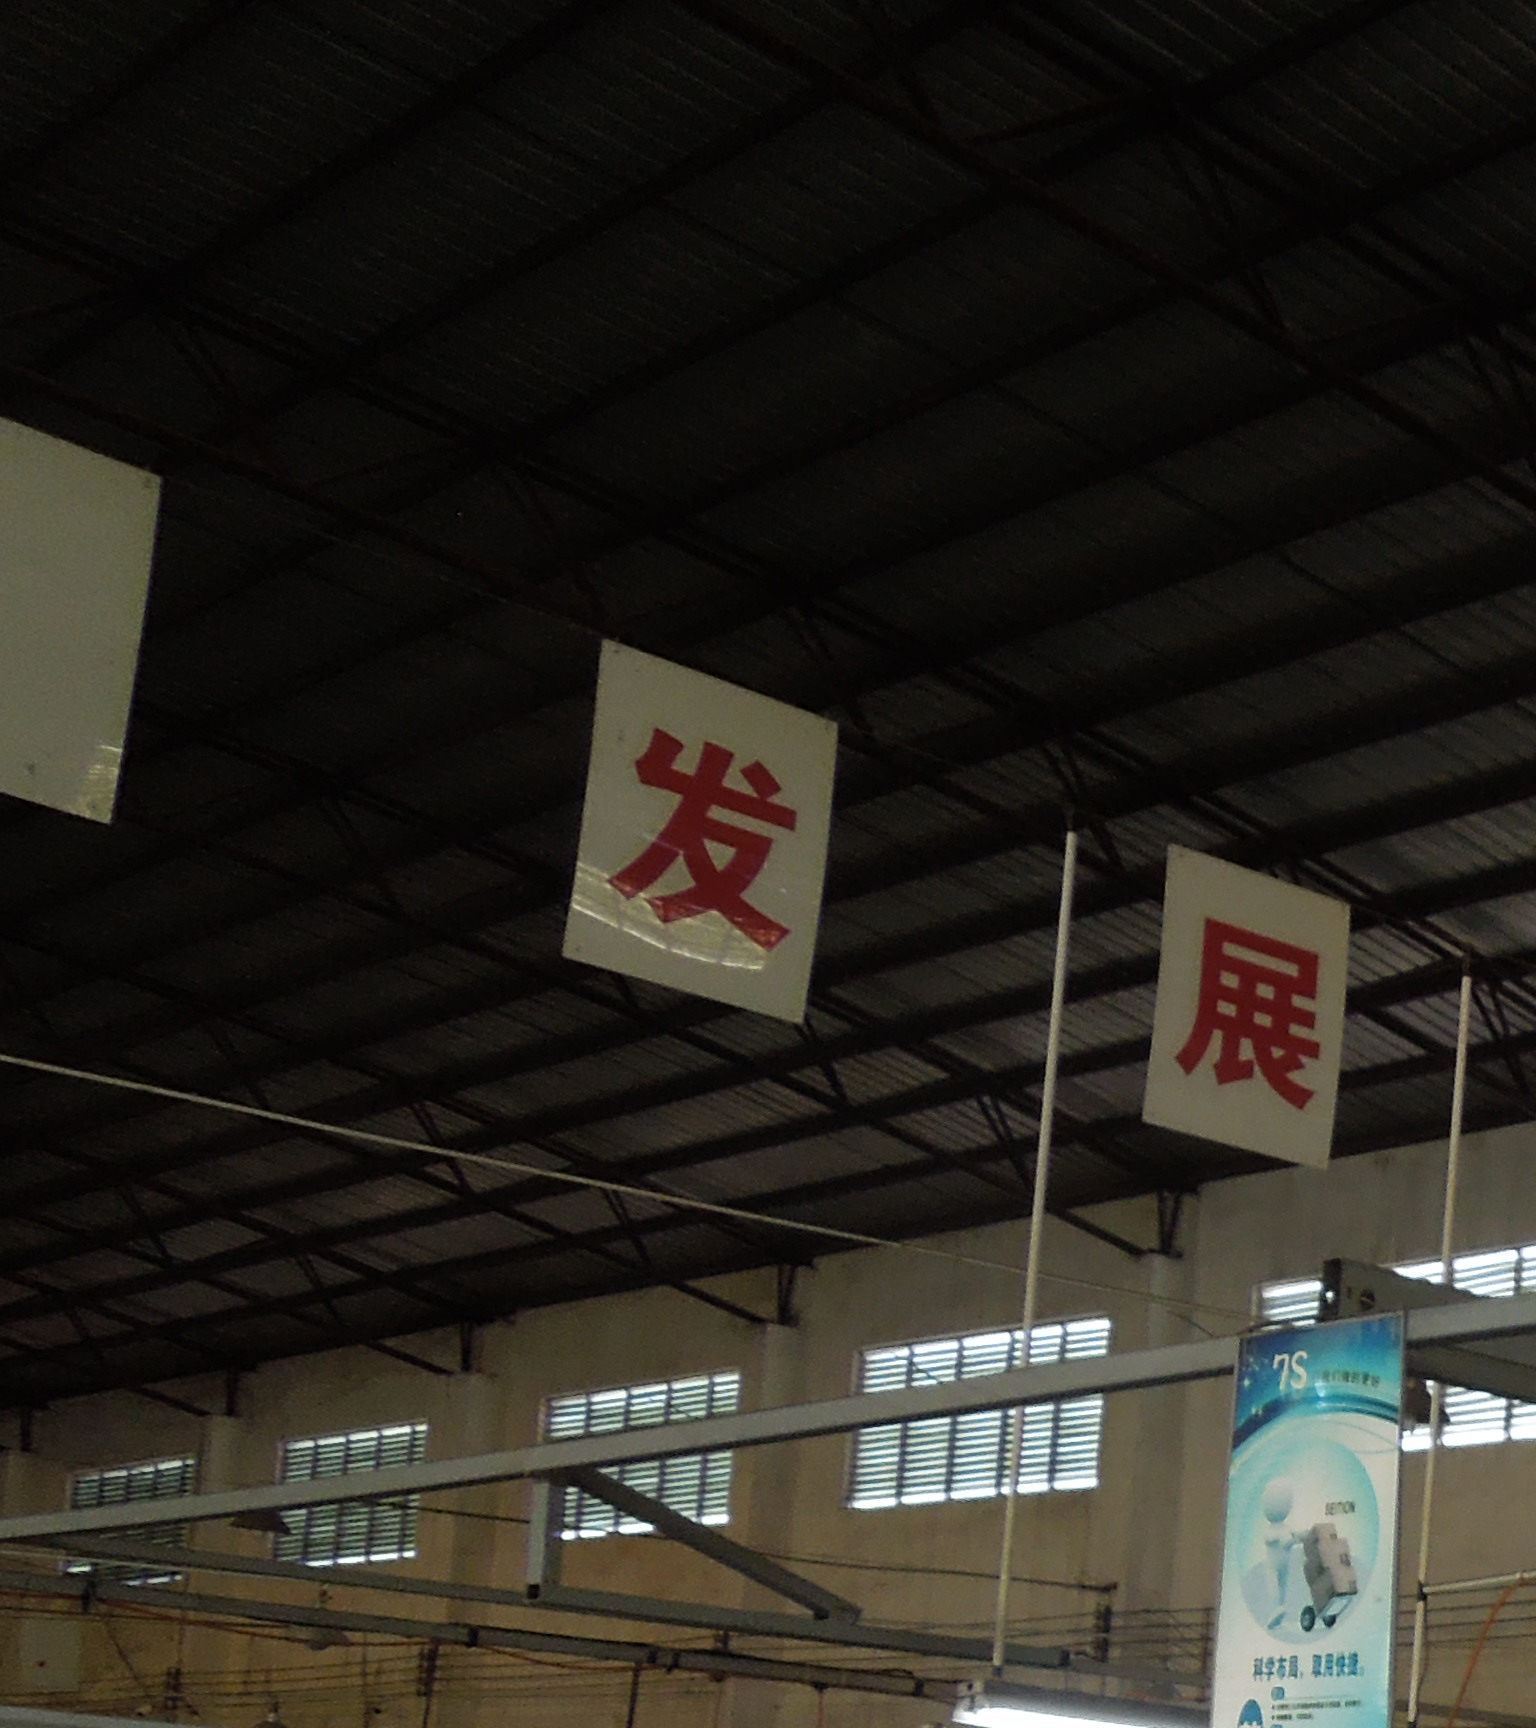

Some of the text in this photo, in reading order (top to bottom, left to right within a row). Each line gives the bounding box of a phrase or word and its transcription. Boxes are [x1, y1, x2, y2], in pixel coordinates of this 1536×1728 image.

[607, 727, 797, 952] 发
[1174, 917, 1323, 1111] 展
[1272, 1350, 1309, 1391] 7S
